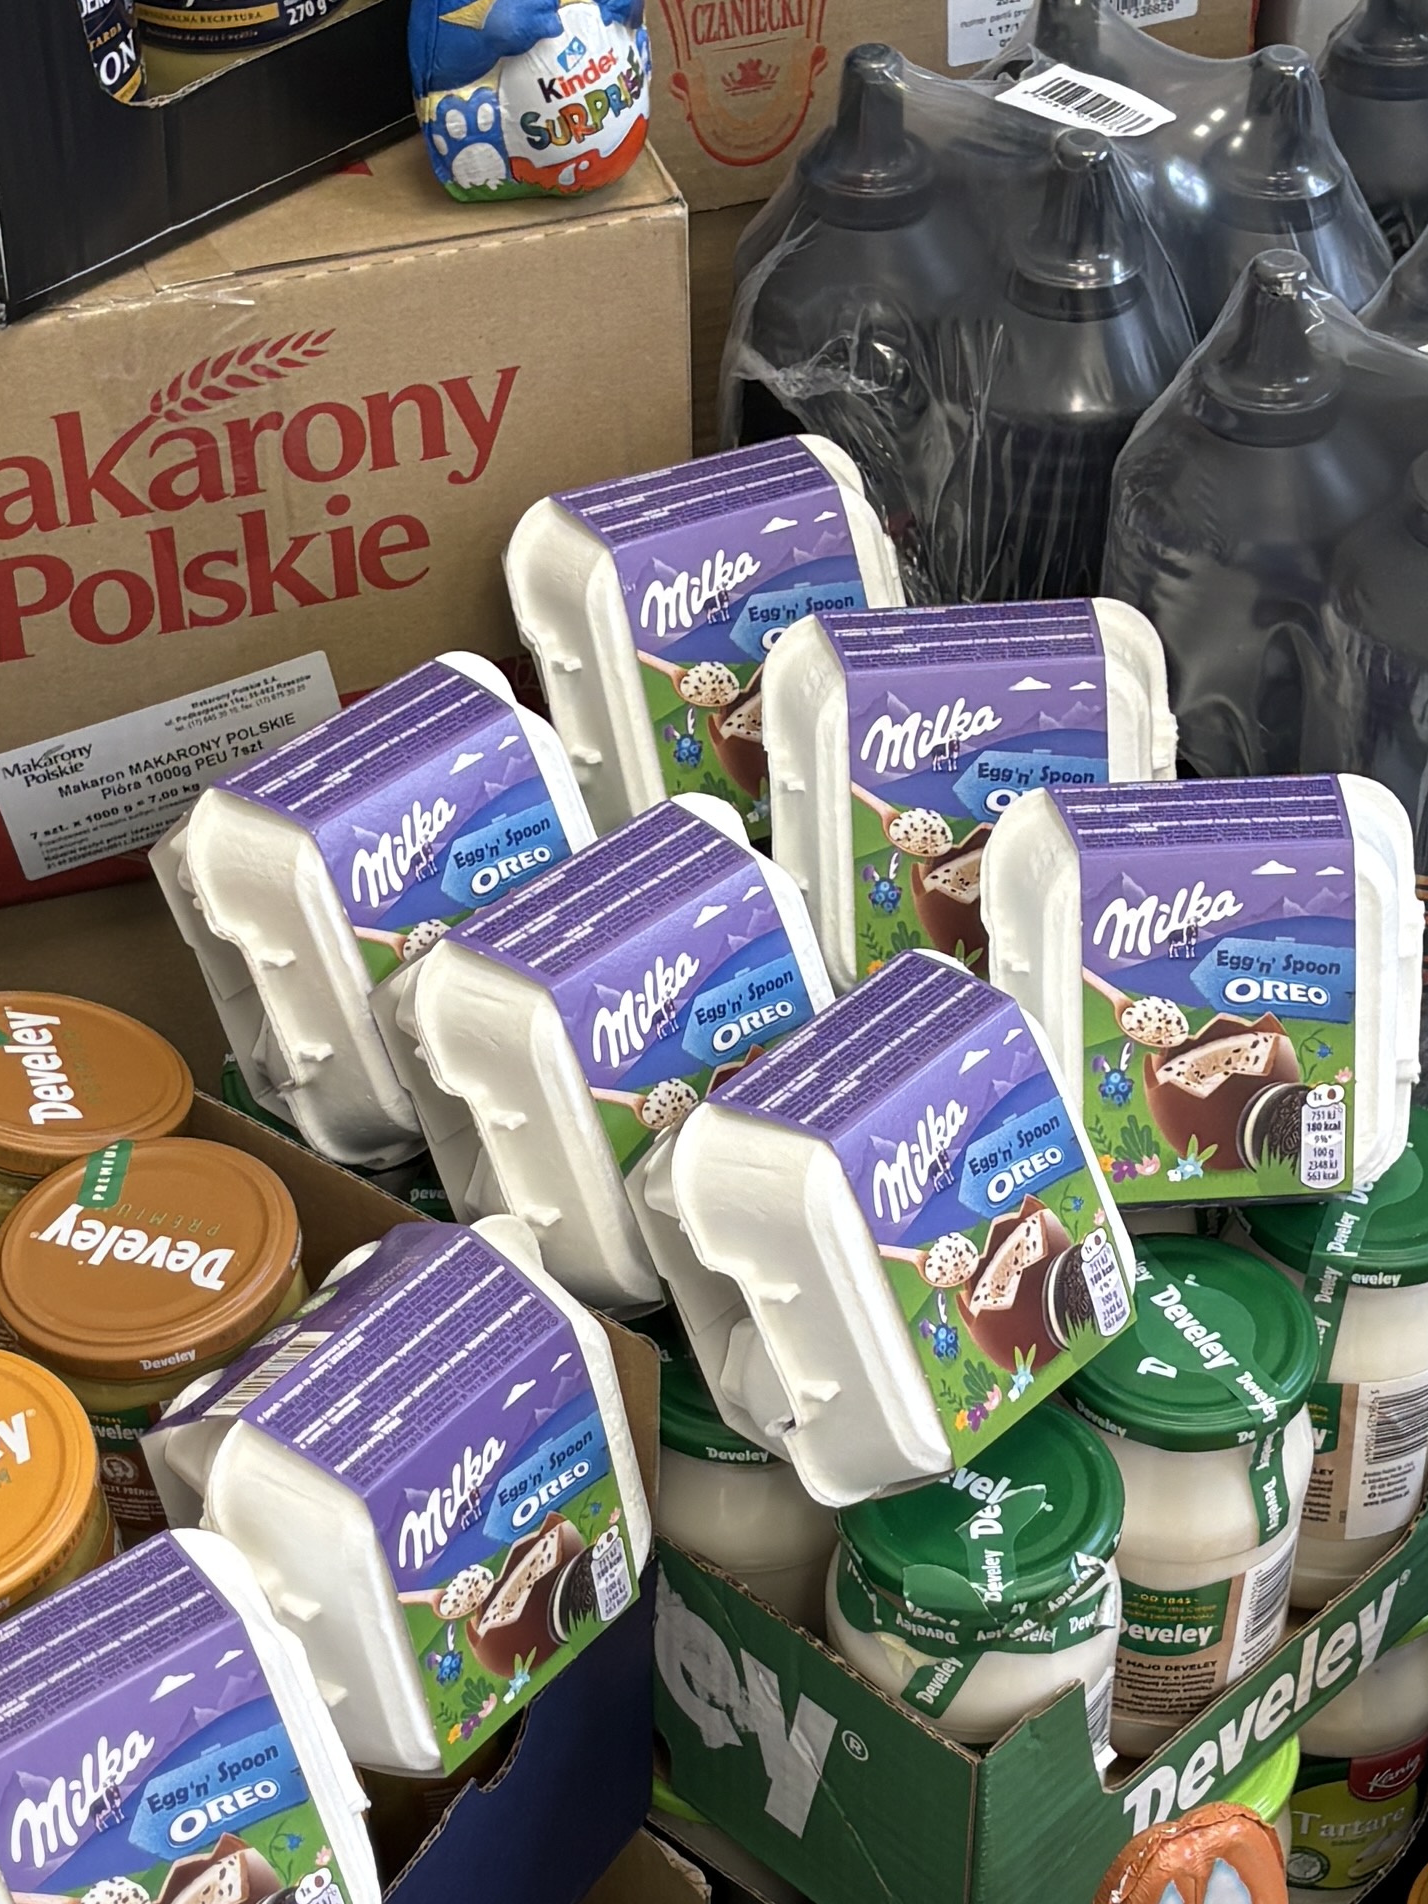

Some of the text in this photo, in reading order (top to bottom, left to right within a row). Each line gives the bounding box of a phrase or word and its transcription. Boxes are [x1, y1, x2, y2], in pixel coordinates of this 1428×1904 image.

[287, 3, 315, 26] 270
[521, 48, 645, 152] SURPRISE
[640, 549, 761, 636] Milka
[805, 594, 855, 614] Spoon
[2, 744, 92, 778] Makarony
[24, 759, 84, 787] Polskie
[58, 713, 295, 798] Makaron MAKARONY POLSKIE
[146, 766, 191, 787] 1000g
[195, 752, 227, 771] PEU
[232, 740, 264, 758] 7szt
[861, 697, 1002, 774] Milka
[86, 807, 120, 823] 1000
[351, 797, 456, 907] Milka
[471, 846, 553, 894] OREO
[1093, 881, 1243, 959] Milka
[592, 953, 699, 1068] Milka
[1225, 978, 1328, 1005] OREO
[4, 1011, 83, 1126] Develey
[873, 1098, 968, 1224] Milka
[38, 1205, 239, 1291] Develey
[1158, 1281, 1240, 1373] Develey
[1124, 1573, 1399, 1833] Develey
[1291, 1803, 1406, 1842] Tartare
